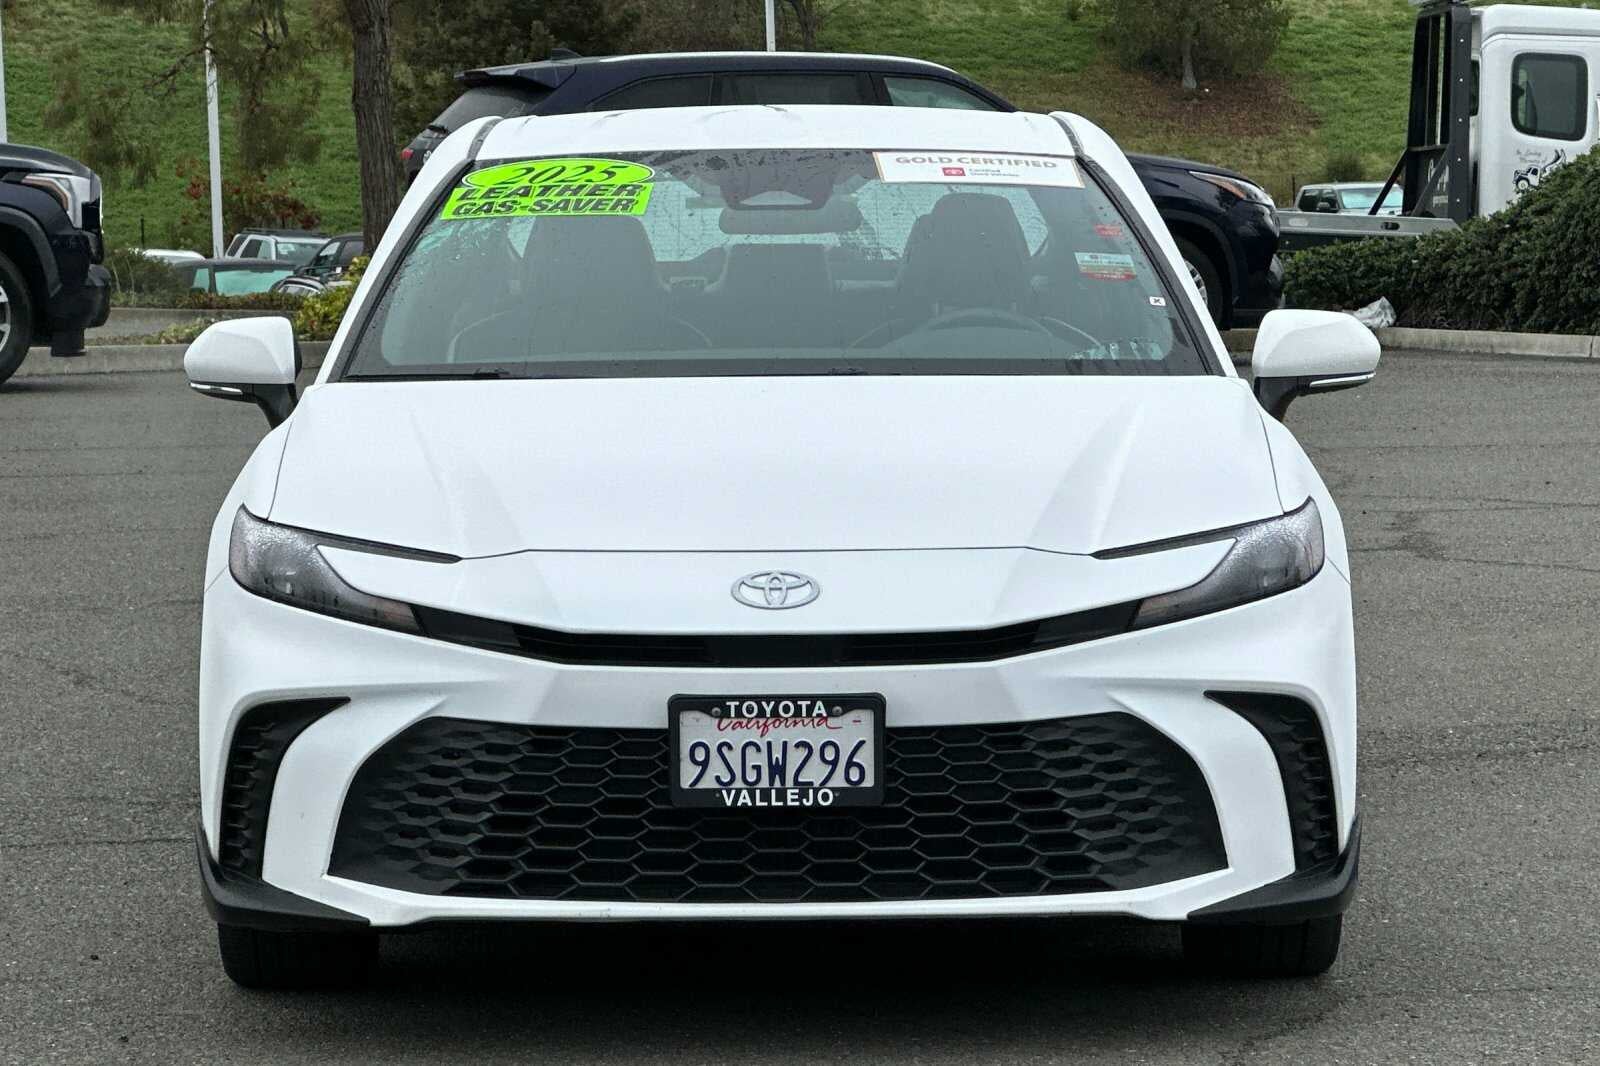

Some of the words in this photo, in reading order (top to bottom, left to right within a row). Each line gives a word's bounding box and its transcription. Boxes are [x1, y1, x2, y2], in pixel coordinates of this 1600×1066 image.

[896, 156, 952, 165] GOLD
[957, 156, 1057, 169] CERTIFIED
[498, 165, 630, 185] 2025
[457, 184, 644, 200] LEATHER
[453, 198, 637, 215] GAS-SAVER
[726, 701, 828, 718] TOYOTA
[717, 716, 843, 737] California
[688, 739, 867, 787] 9SGW296
[721, 788, 834, 806] VALLEJO
